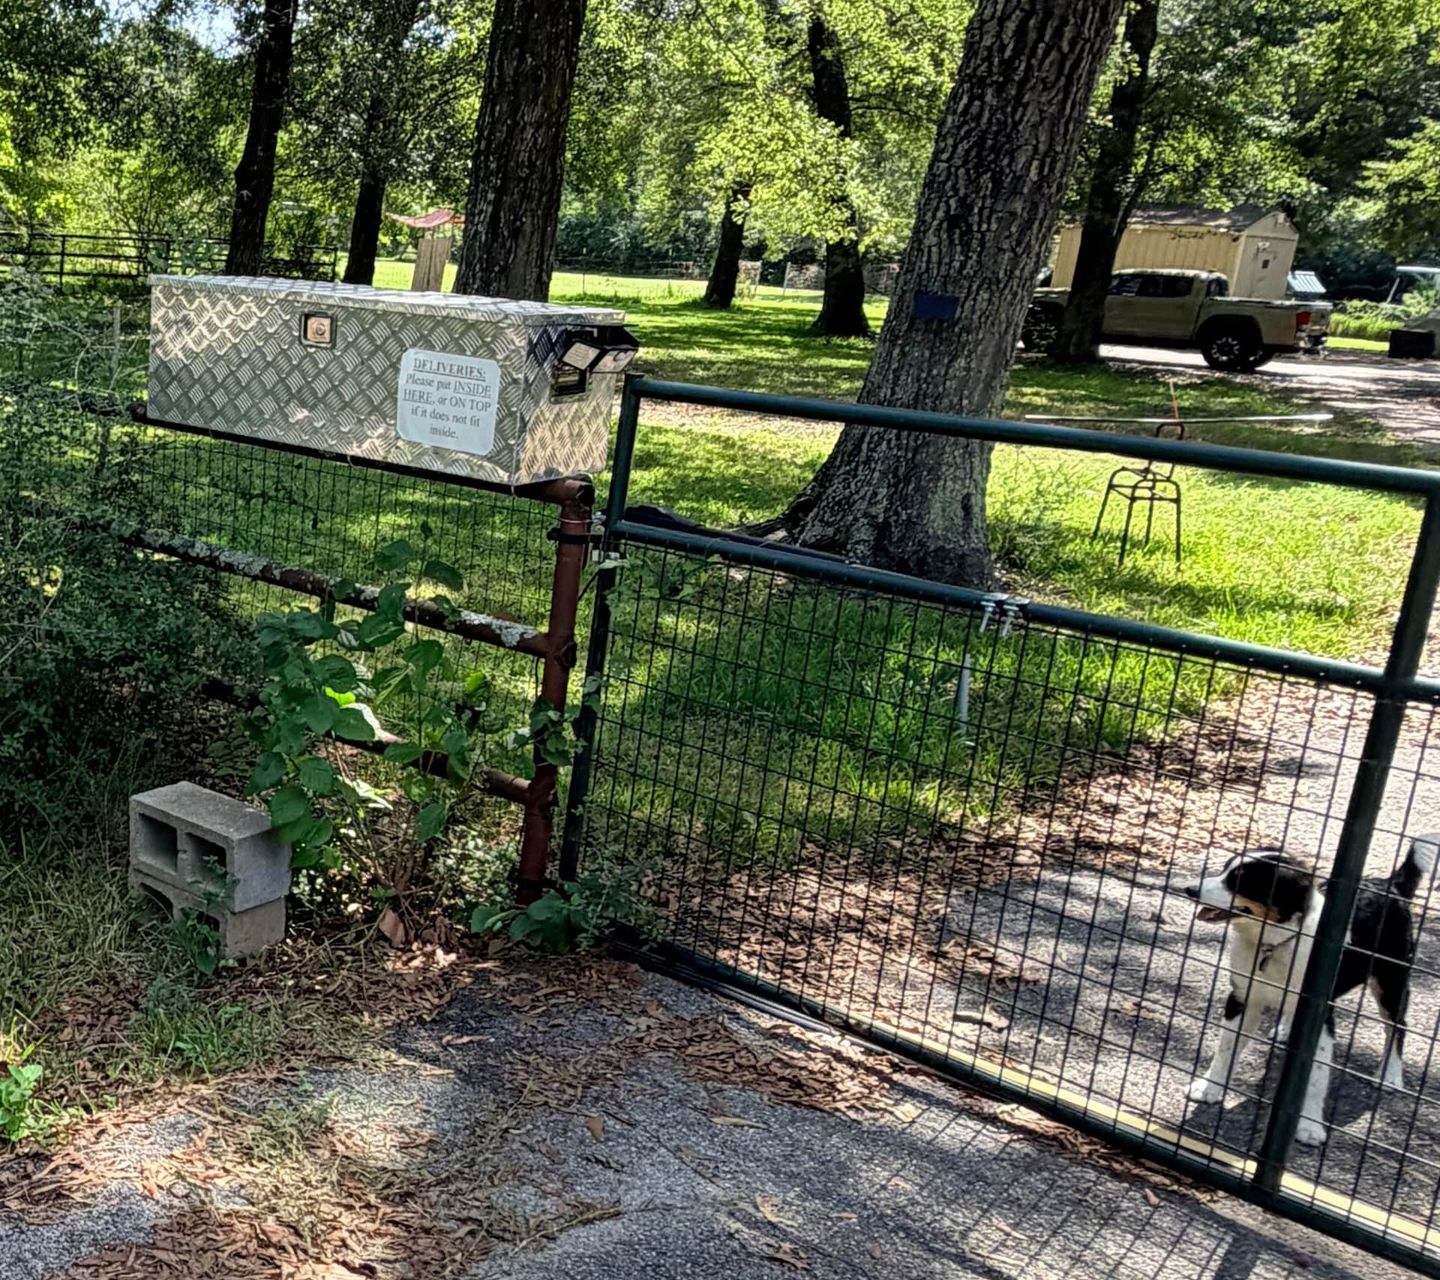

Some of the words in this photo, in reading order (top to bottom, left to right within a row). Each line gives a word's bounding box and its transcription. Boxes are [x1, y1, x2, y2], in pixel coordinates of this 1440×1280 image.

[414, 358, 486, 380] DELIVERIES:
[406, 373, 434, 387] Please
[454, 381, 491, 396] INSIDE
[403, 389, 435, 404] HERE,
[438, 397, 447, 405] or
[450, 396, 465, 408] ON
[470, 399, 491, 412] TOP
[411, 405, 419, 416] if
[421, 409, 427, 417] it
[430, 409, 449, 421] does
[453, 415, 467, 424] not
[470, 415, 480, 427] fit
